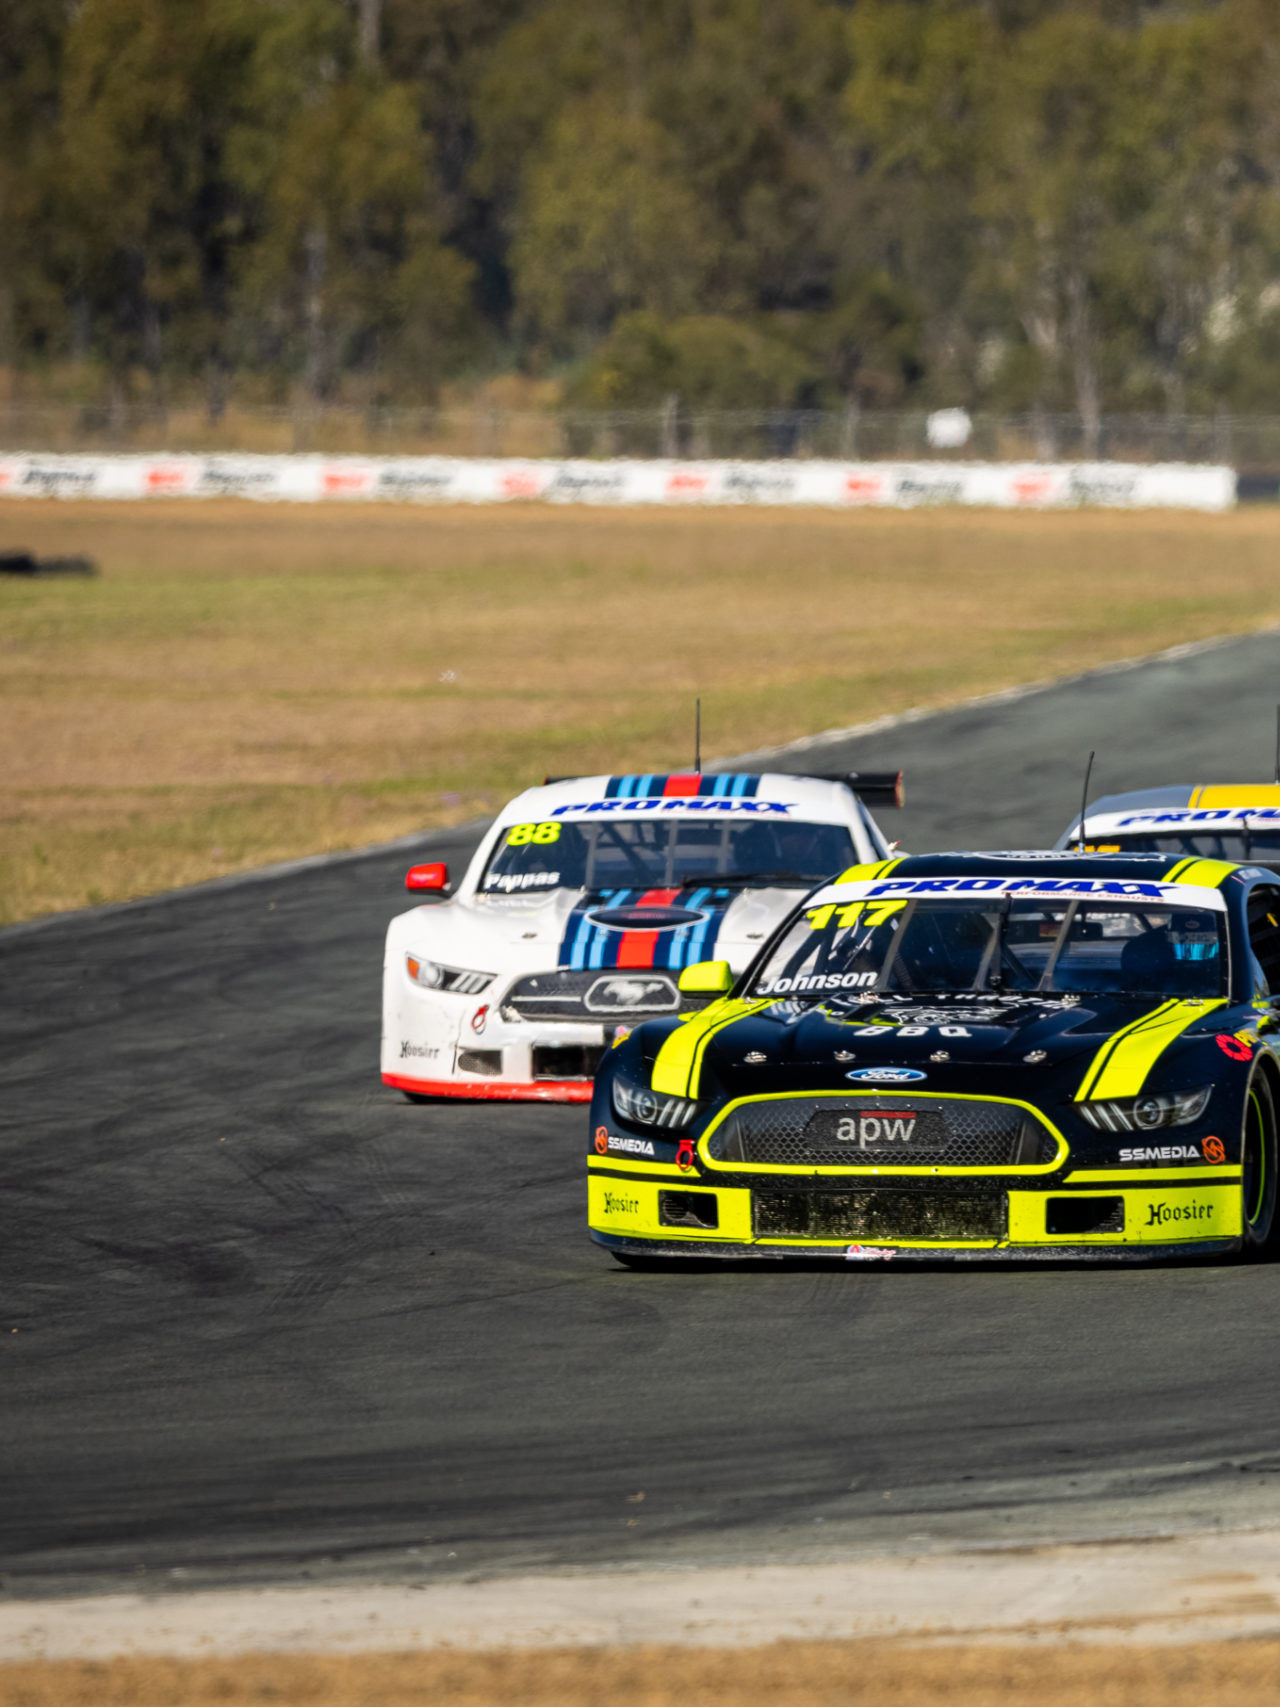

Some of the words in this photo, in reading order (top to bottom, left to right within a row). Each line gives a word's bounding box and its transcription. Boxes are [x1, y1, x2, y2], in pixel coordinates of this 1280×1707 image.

[550, 799, 800, 817] PROMAXX
[506, 821, 562, 846] 88
[483, 872, 560, 891] Pappas
[864, 878, 1181, 898] PROMAXX
[806, 899, 908, 930] 117
[756, 971, 878, 994] Johnson
[400, 1040, 440, 1058] Hoosier
[860, 1068, 911, 1081] Ford
[836, 1116, 917, 1149] apw
[607, 1136, 655, 1155] SSMEDIA
[1119, 1145, 1200, 1161] SSMEDIA
[604, 1191, 639, 1214] Hoosier
[1144, 1200, 1214, 1225] Hoosier
